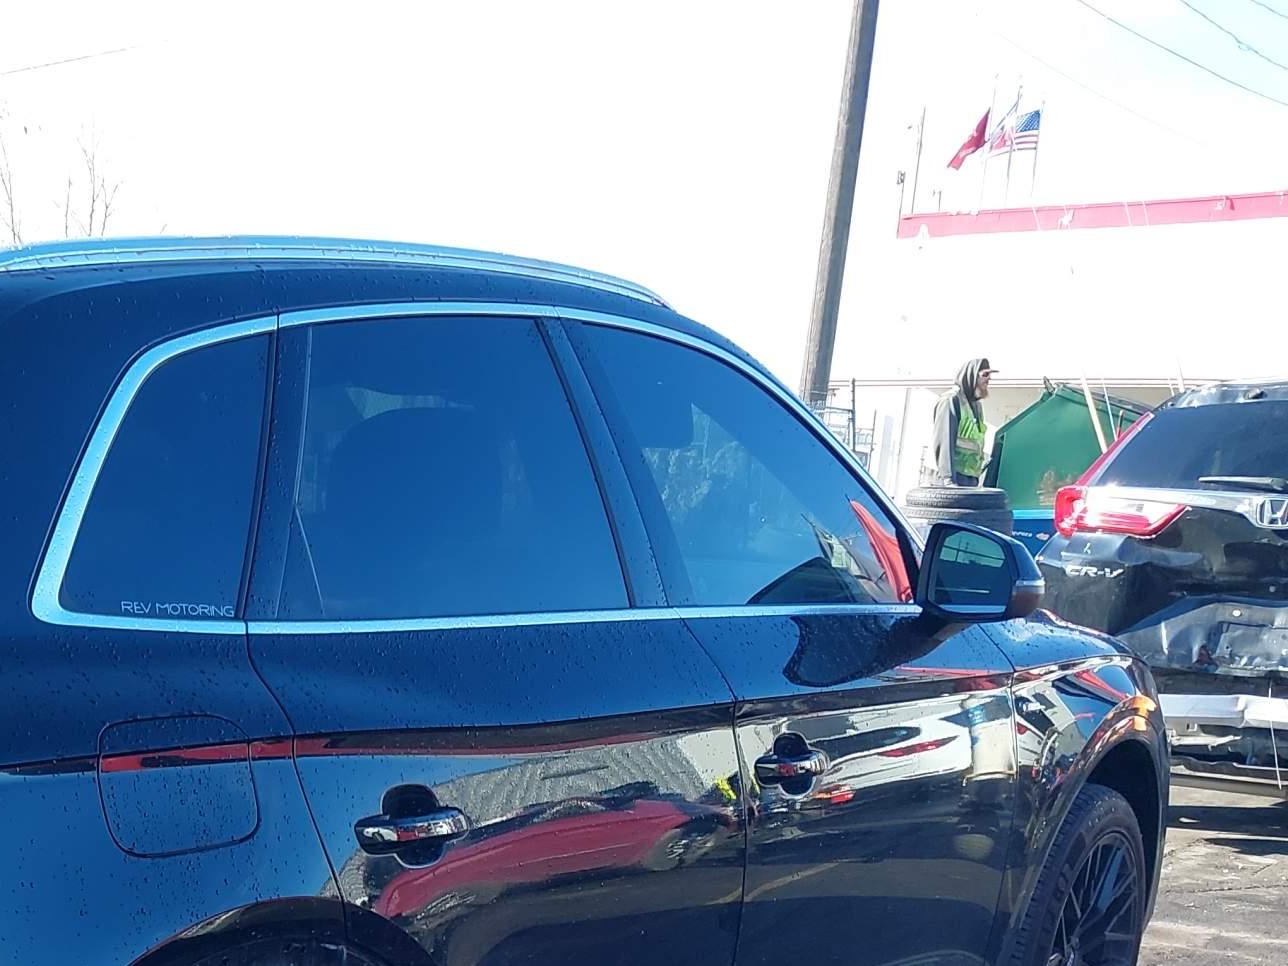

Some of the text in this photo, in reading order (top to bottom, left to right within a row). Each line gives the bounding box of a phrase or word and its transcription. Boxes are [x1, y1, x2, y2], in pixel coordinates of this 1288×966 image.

[1066, 564, 1124, 578] CR-V
[120, 600, 235, 618] REV MOTORING
